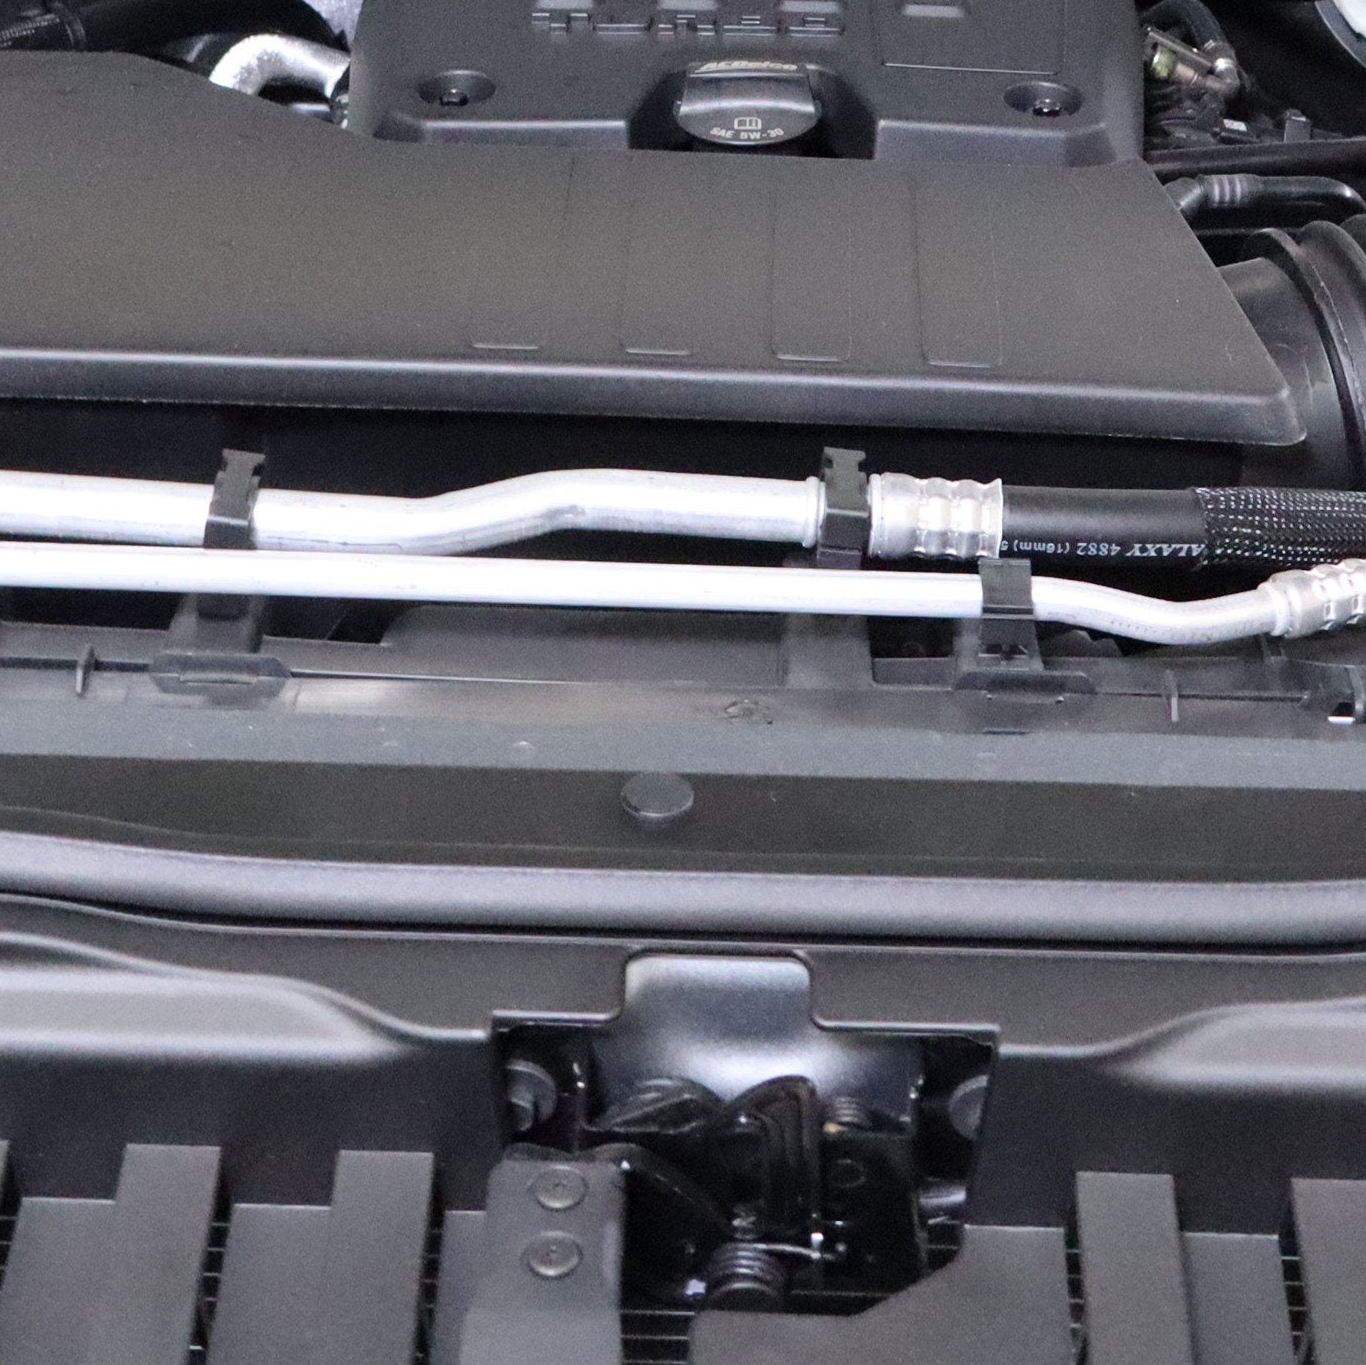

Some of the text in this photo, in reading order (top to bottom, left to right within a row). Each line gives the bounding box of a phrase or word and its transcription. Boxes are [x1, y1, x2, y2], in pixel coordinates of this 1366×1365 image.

[709, 127, 784, 140] SAE 5W-30
[1013, 539, 1071, 555] (16mm)
[1076, 542, 1121, 556] 4882
[1126, 543, 1207, 557] ALAXY
